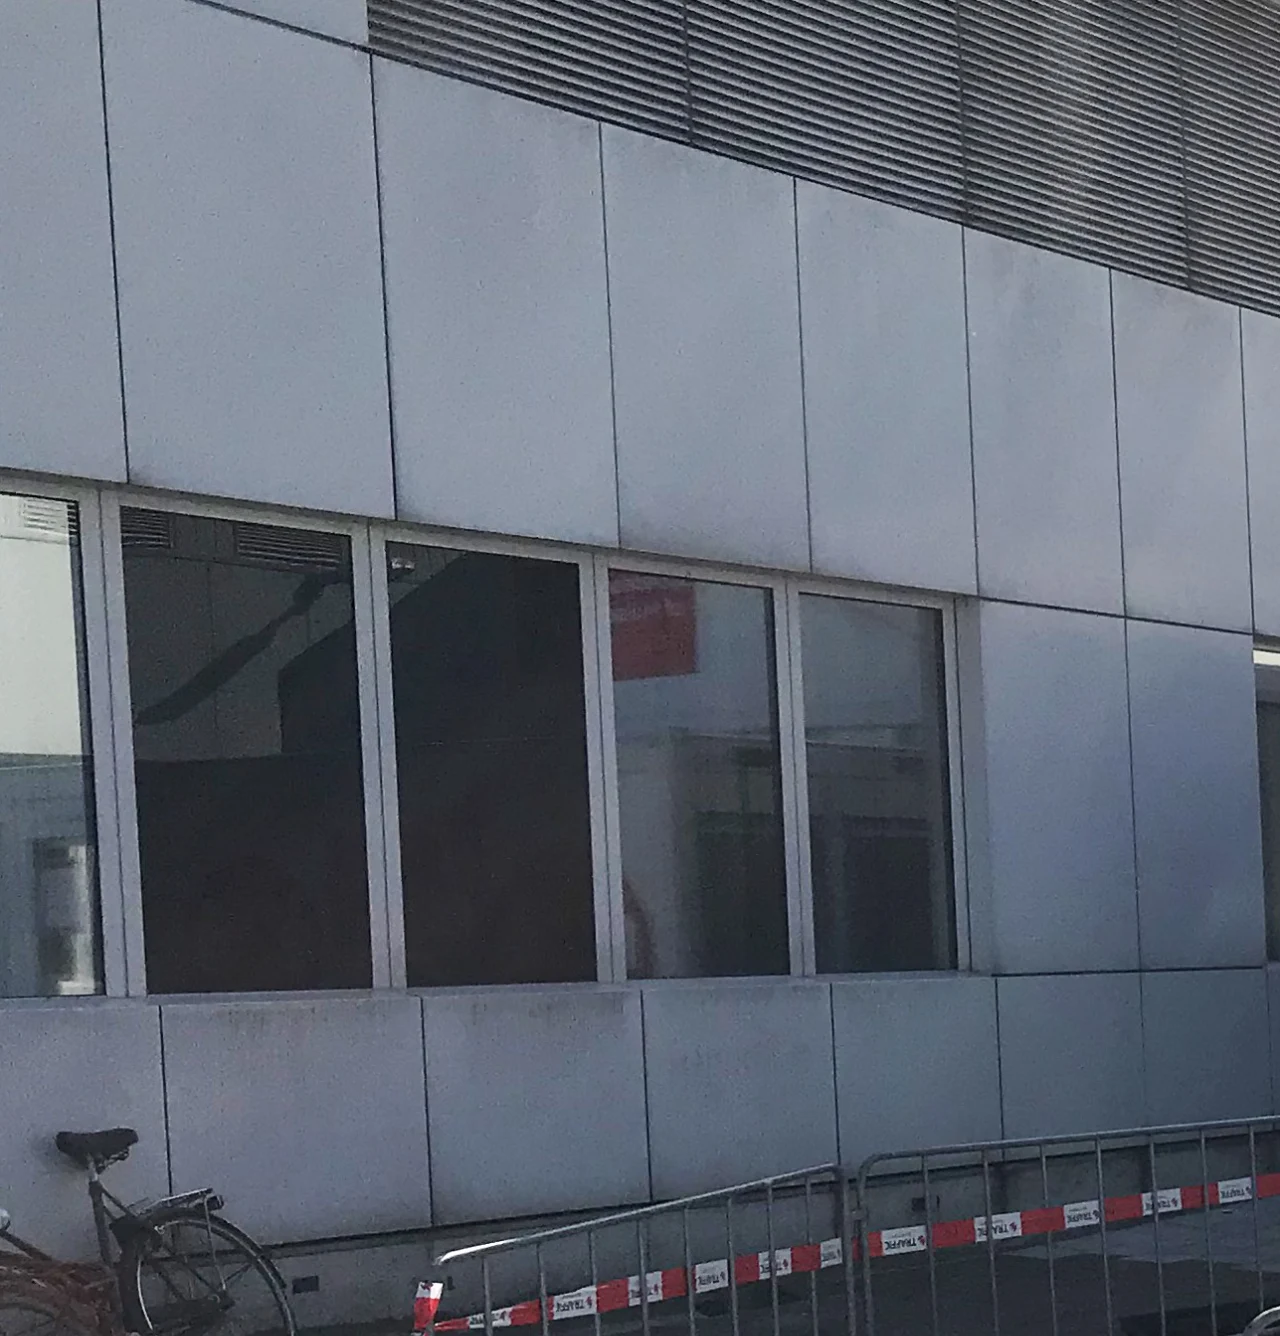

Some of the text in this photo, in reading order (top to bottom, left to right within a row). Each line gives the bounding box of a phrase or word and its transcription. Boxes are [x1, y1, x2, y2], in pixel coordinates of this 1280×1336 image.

[1067, 1210, 1093, 1223] TRAFFIC
[978, 1224, 1008, 1236] TRAFIC
[885, 1238, 917, 1250] TRAFFIC
